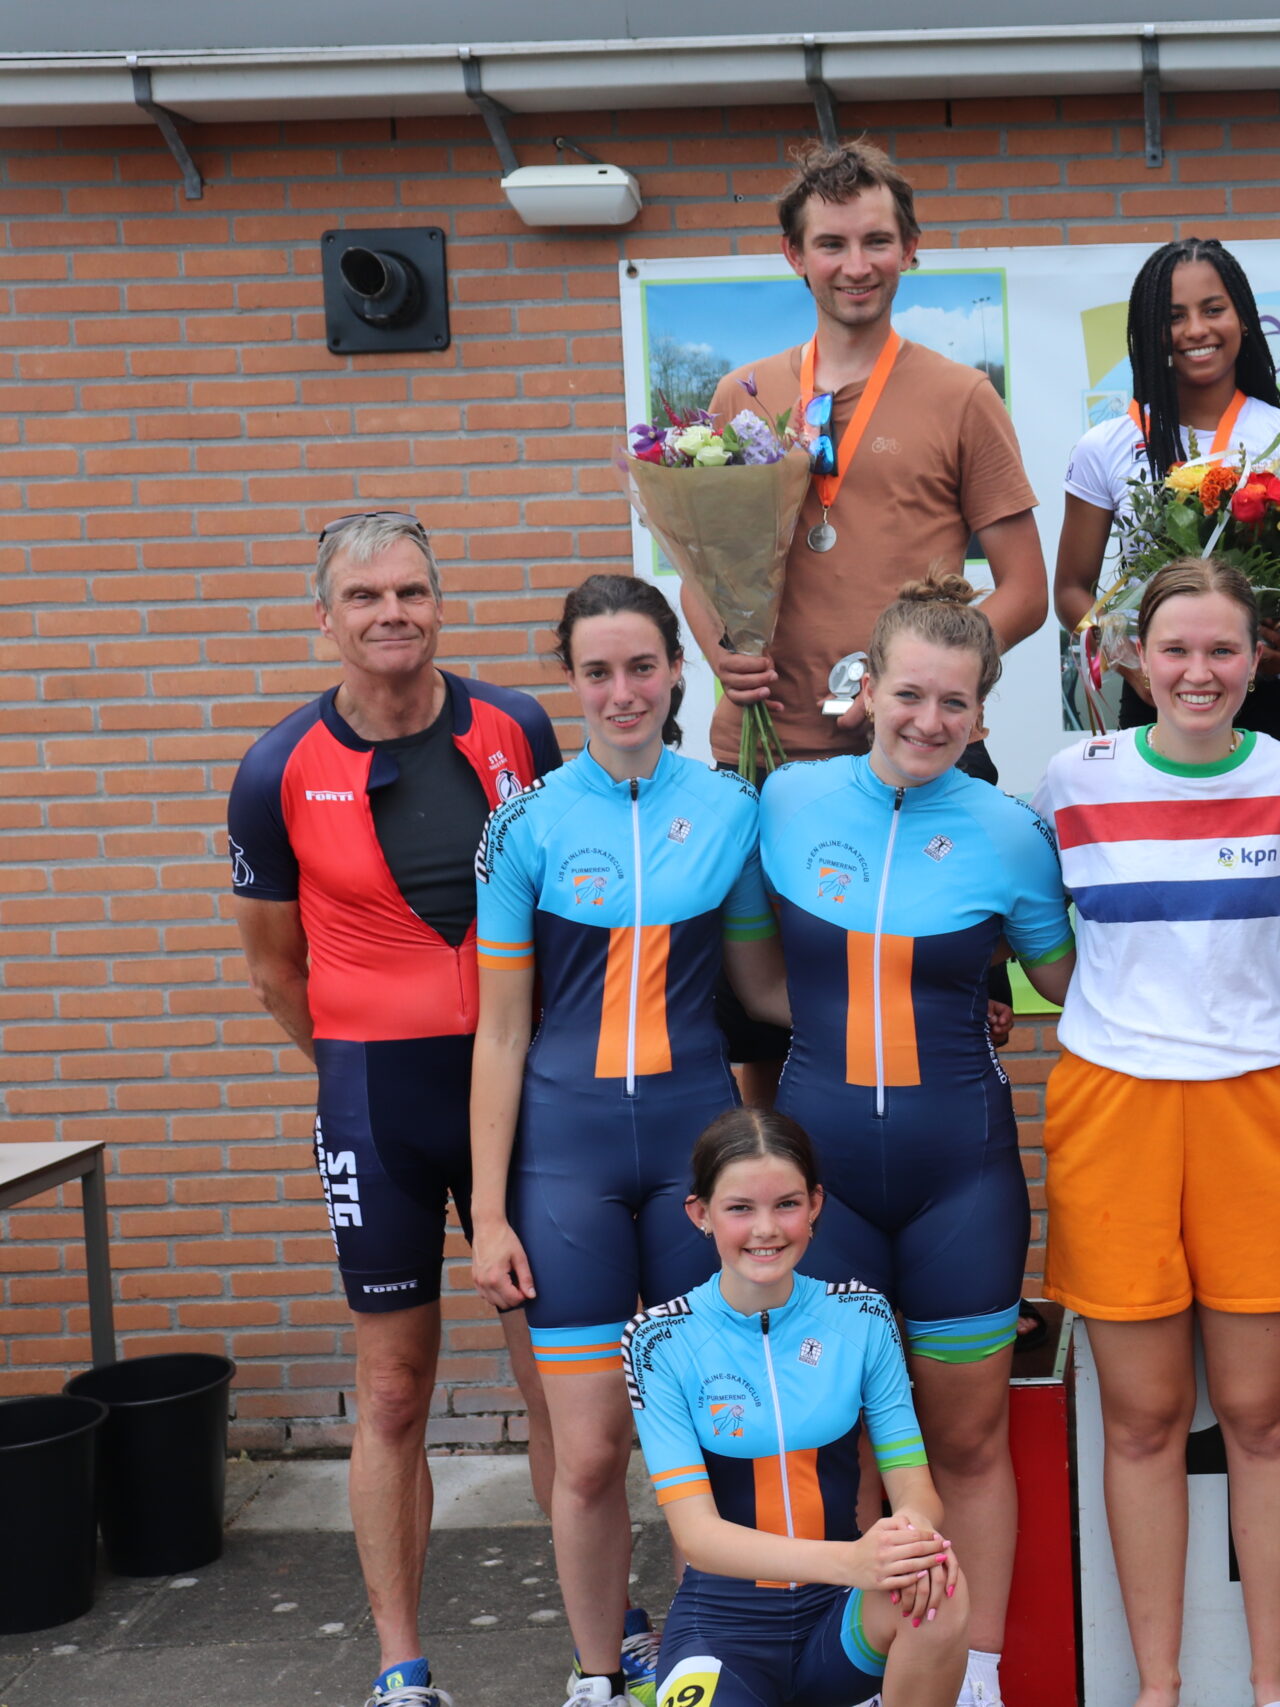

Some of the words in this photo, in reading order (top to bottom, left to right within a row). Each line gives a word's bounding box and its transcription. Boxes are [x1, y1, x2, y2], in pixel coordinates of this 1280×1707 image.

[568, 847, 624, 880] INLINE-SKATECLUB
[818, 840, 870, 883] INLINE-SKATECLUB
[819, 857, 857, 872] PURMEREND
[1241, 848, 1277, 866] kpn
[327, 1151, 364, 1227] STG
[643, 1327, 673, 1372] Achterveld
